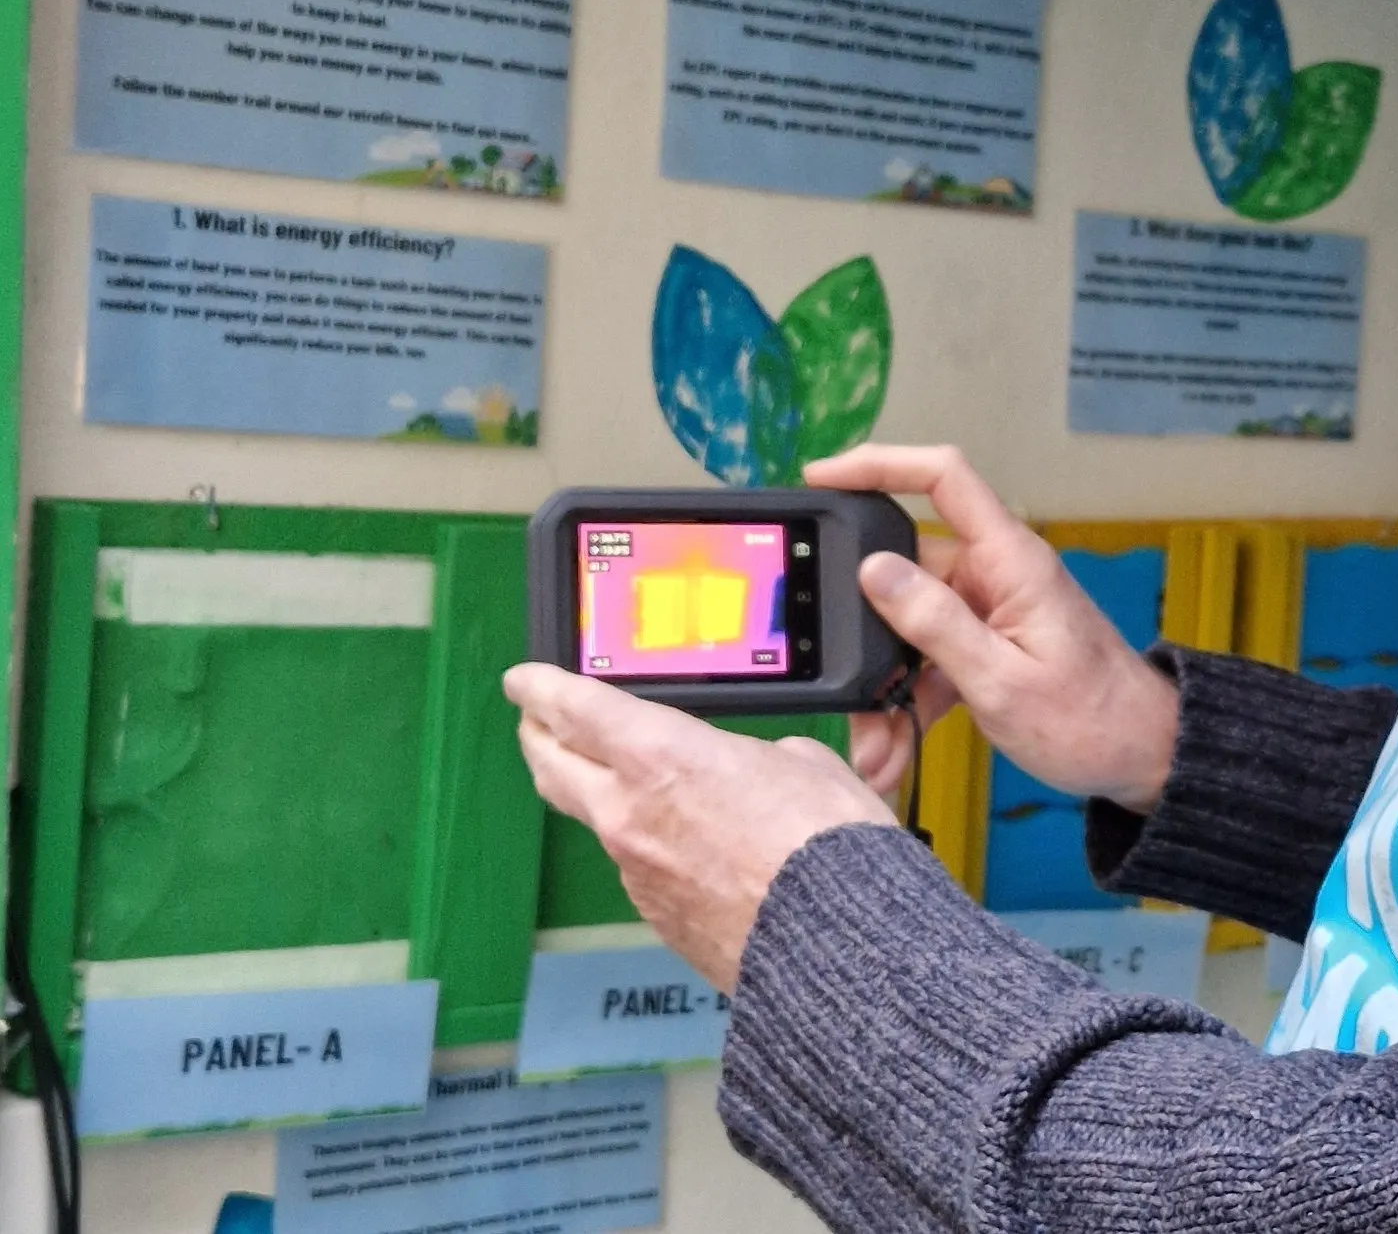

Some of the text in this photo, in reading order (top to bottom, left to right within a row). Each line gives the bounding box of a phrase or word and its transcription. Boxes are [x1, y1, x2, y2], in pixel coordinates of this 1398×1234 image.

[170, 204, 456, 263] 1. What is energy efficiency?
[319, 1028, 343, 1062] A
